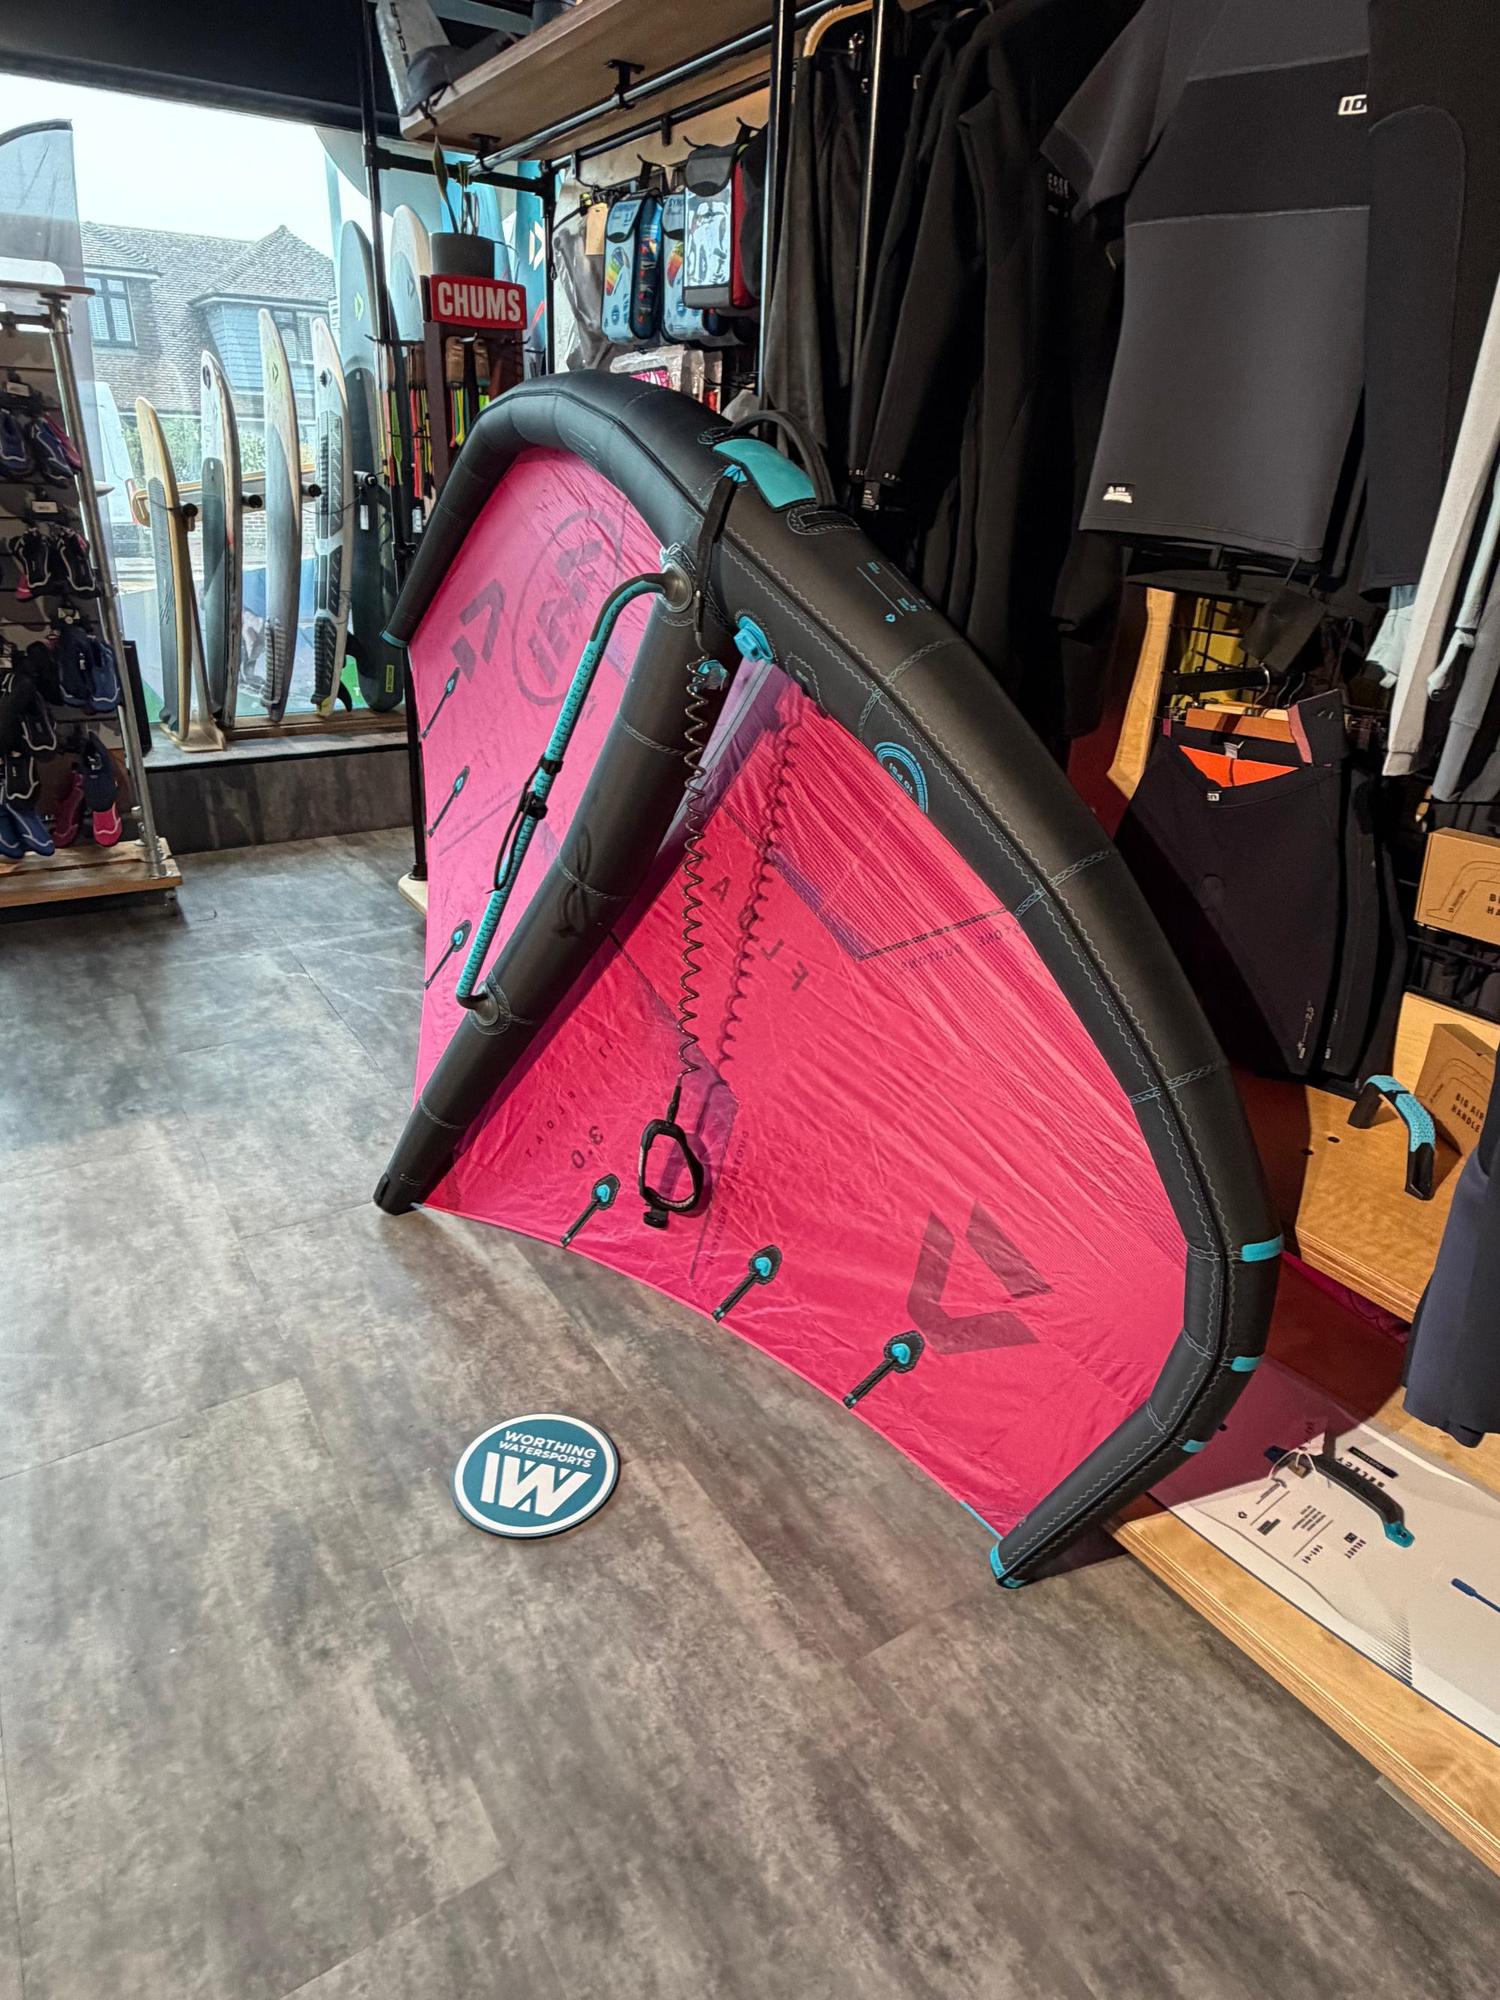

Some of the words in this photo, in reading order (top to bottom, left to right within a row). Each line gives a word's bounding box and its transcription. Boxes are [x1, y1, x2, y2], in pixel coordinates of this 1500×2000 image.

[438, 281, 521, 322] CHUMS
[1451, 1104, 1481, 1133] HANDLE
[1470, 1106, 1484, 1120] AIR
[499, 1440, 592, 1468] WATERSPORTS
[504, 1430, 597, 1459] WORTHING
